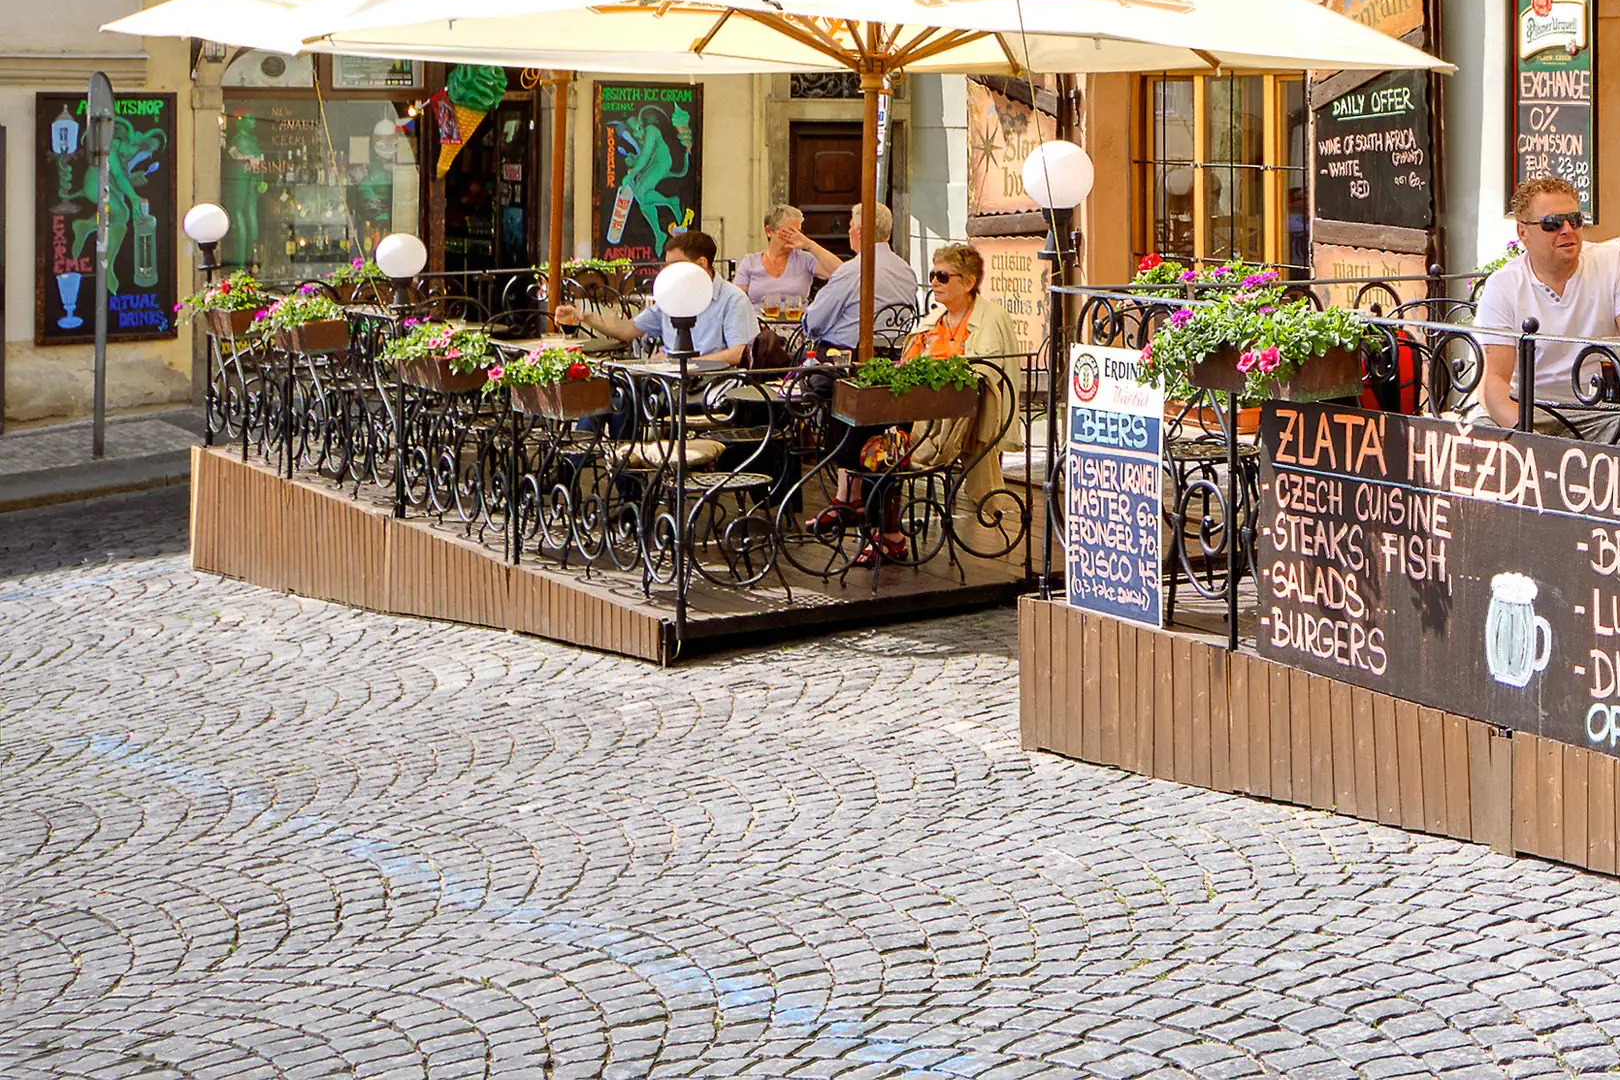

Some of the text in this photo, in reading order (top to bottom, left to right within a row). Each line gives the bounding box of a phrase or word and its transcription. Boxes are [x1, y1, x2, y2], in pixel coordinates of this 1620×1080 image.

[1332, 87, 1415, 116] DAILY OFFER
[1520, 70, 1590, 99] EXCHANGE
[1530, 105, 1559, 132] 0%
[1318, 136, 1341, 155] WINE
[1385, 128, 1417, 152] AFRICA
[1517, 133, 1583, 156] COMMISSION
[1350, 179, 1370, 199] RED
[1074, 408, 1148, 448] BEERS
[1070, 454, 1120, 493] PILSNER
[1071, 485, 1132, 525] MASTER
[1355, 482, 1452, 539] CUISINE
[1069, 513, 1138, 554] ERDINGER
[1069, 543, 1132, 584] FRISCO
